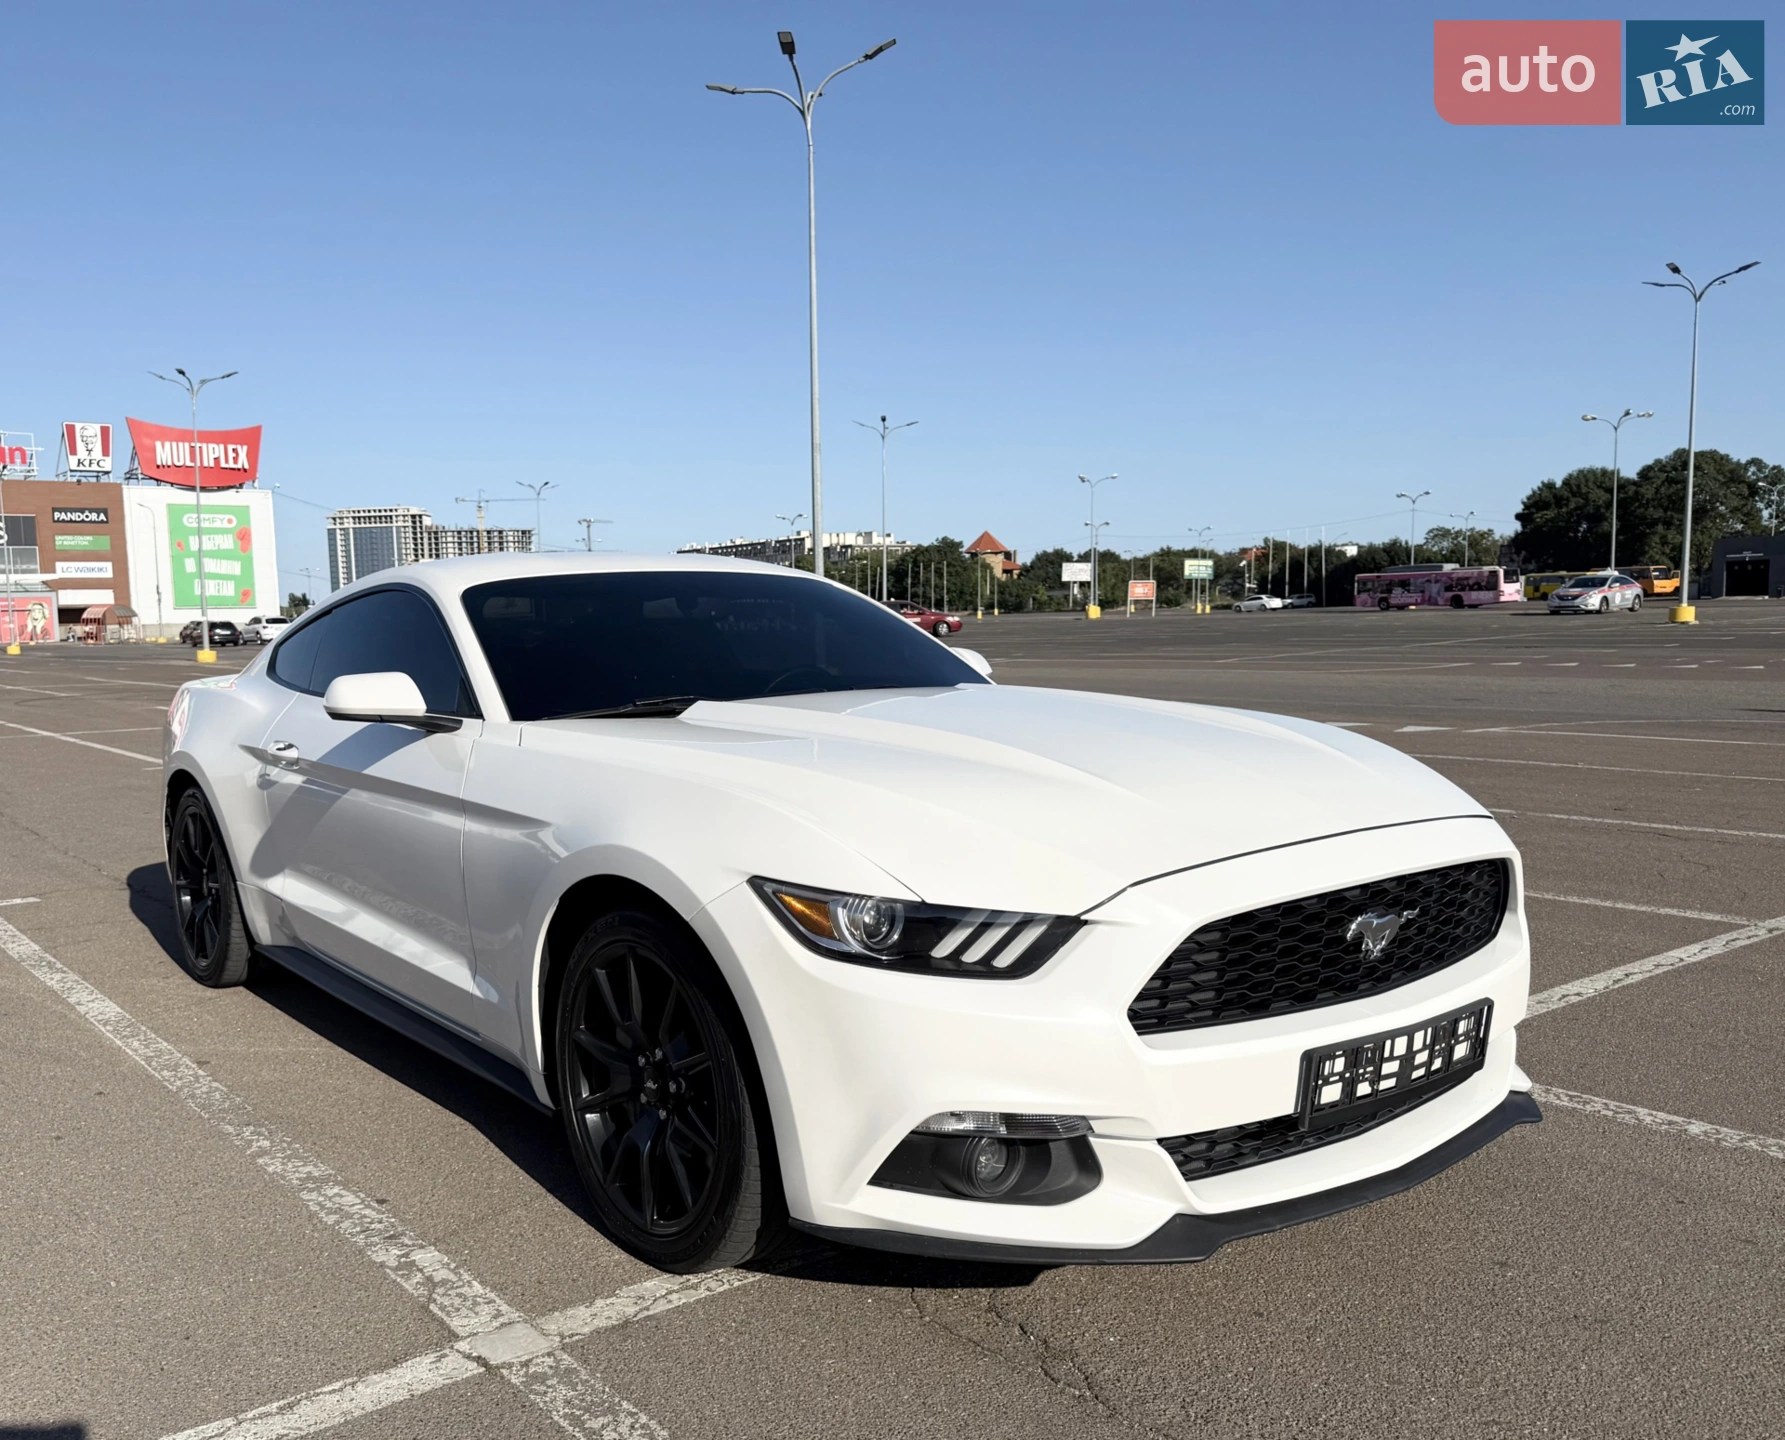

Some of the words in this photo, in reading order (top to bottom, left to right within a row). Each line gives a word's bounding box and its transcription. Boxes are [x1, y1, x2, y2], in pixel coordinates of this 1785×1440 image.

[154, 440, 250, 470] MULTIPLEX
[76, 458, 106, 469] KFC
[53, 511, 107, 522] PANDORA
[186, 516, 225, 525] COMFY
[202, 557, 241, 576] ОМАШНІМ
